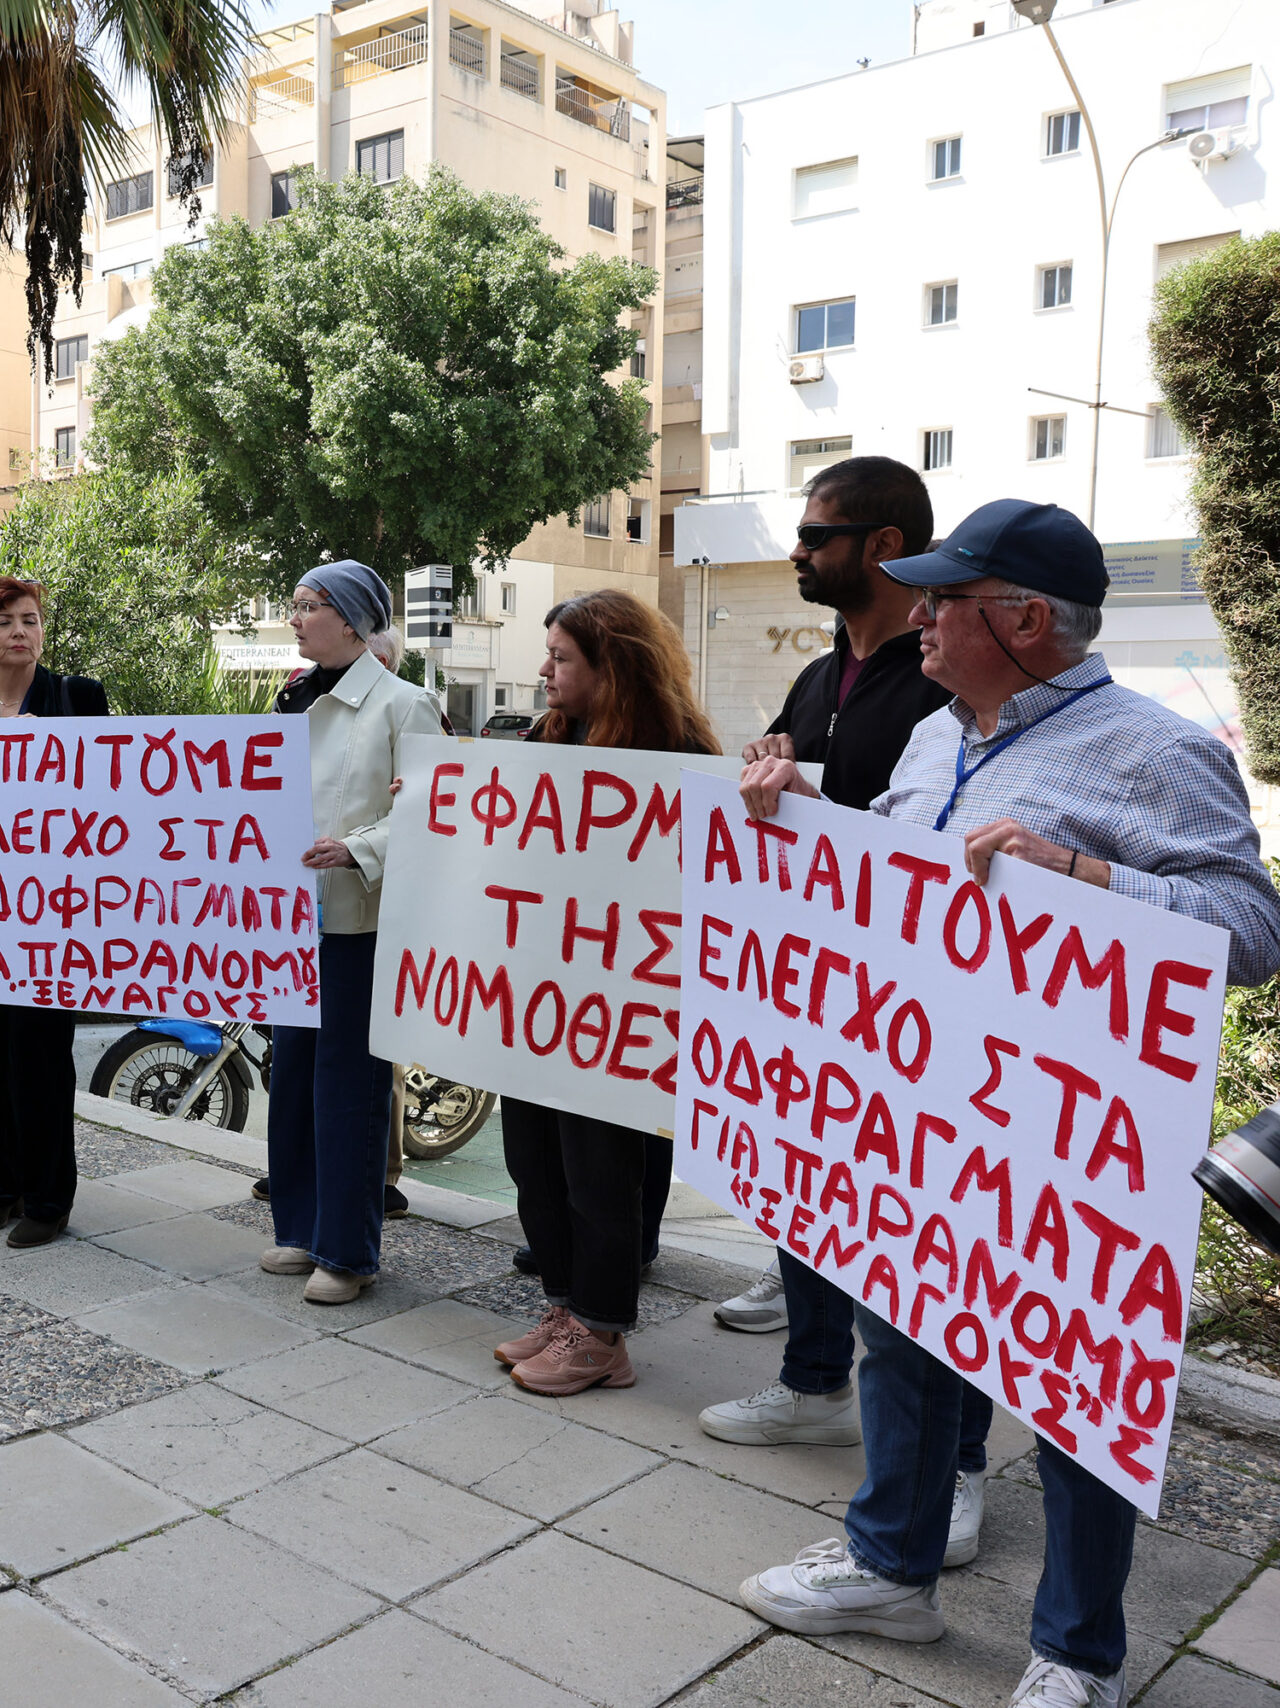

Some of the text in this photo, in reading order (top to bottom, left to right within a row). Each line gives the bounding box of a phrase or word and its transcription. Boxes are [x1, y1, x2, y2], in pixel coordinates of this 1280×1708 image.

[158, 813, 270, 864] ΣΤΑ
[484, 884, 683, 990] ΤΗΣ
[705, 807, 1214, 1083] ΑΠΑΙΤΟΥΜΕ
[699, 914, 1146, 1193] ΕΛΕΓΧΟ ΣΤΑ
[691, 1098, 760, 1179] ΓΙΑ
